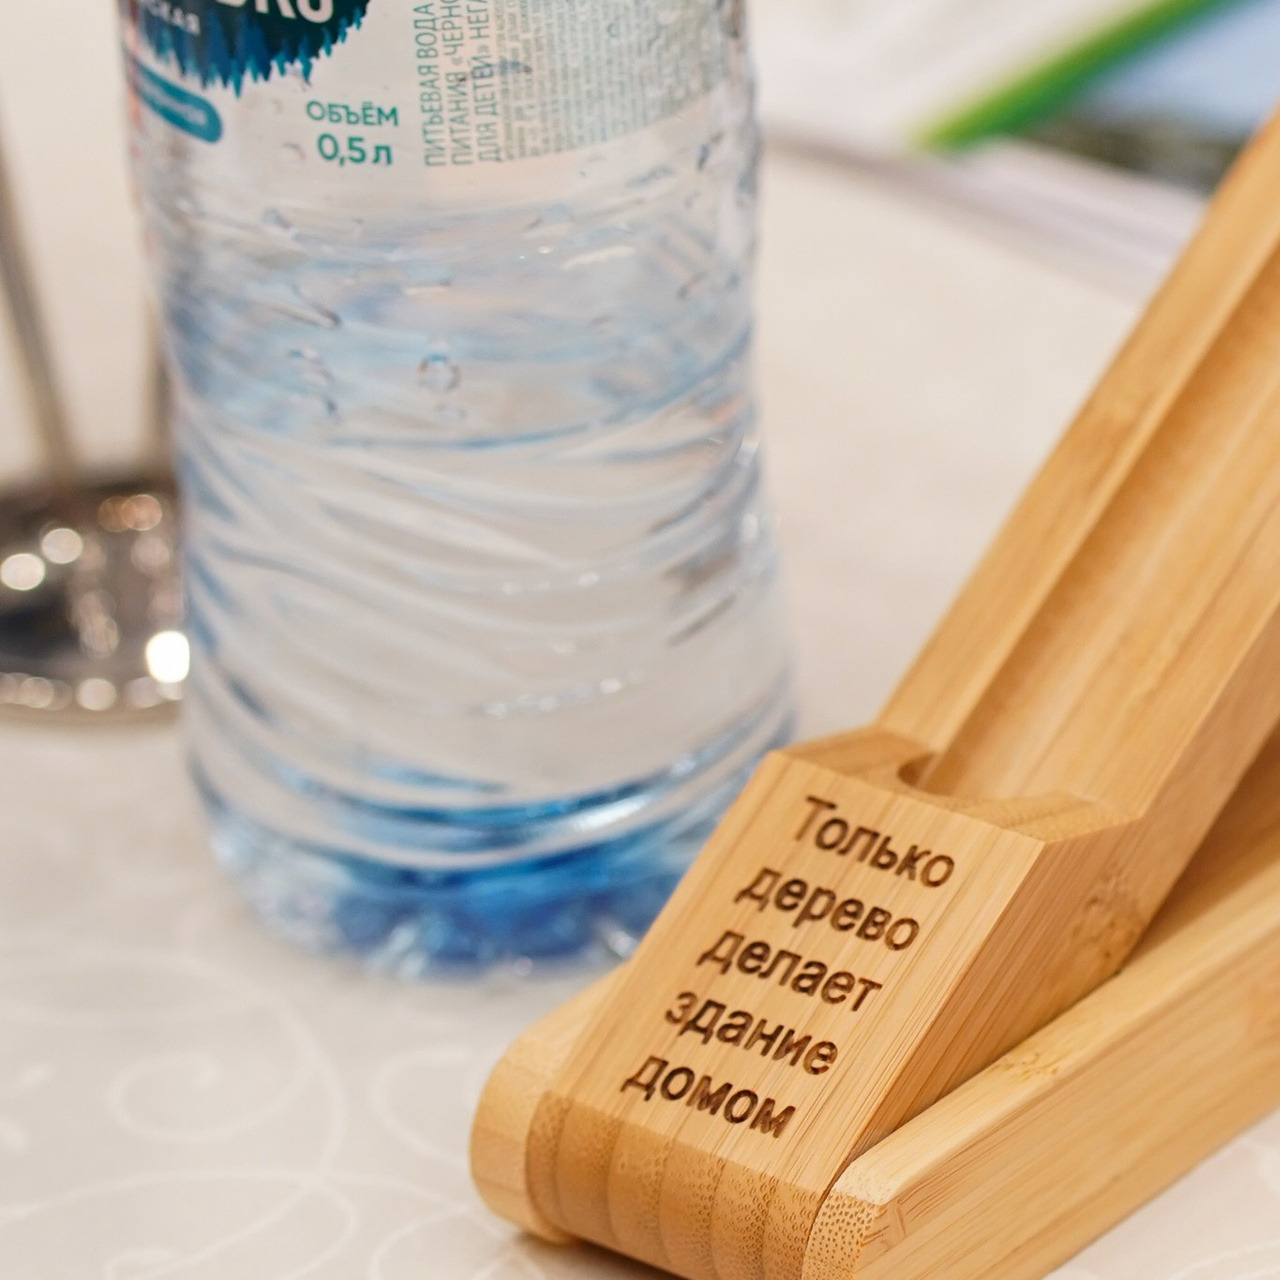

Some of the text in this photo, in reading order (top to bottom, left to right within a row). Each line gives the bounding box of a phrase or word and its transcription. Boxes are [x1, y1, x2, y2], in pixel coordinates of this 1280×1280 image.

[413, 1, 439, 59] ВОДА
[306, 99, 399, 128] ОБЪЁМ
[419, 63, 444, 168] ПИТЬЕВАЯ
[445, 70, 471, 166] ПИТАНИЯ
[469, 42, 495, 117] ДЕТЕЙ»
[317, 133, 393, 167] 0,5 л
[474, 121, 499, 164] ДЛЯ
[786, 795, 955, 889] Только
[735, 866, 921, 952] дерево
[696, 927, 884, 1014] делает
[664, 986, 840, 1077] здание
[622, 1053, 798, 1140] домом
